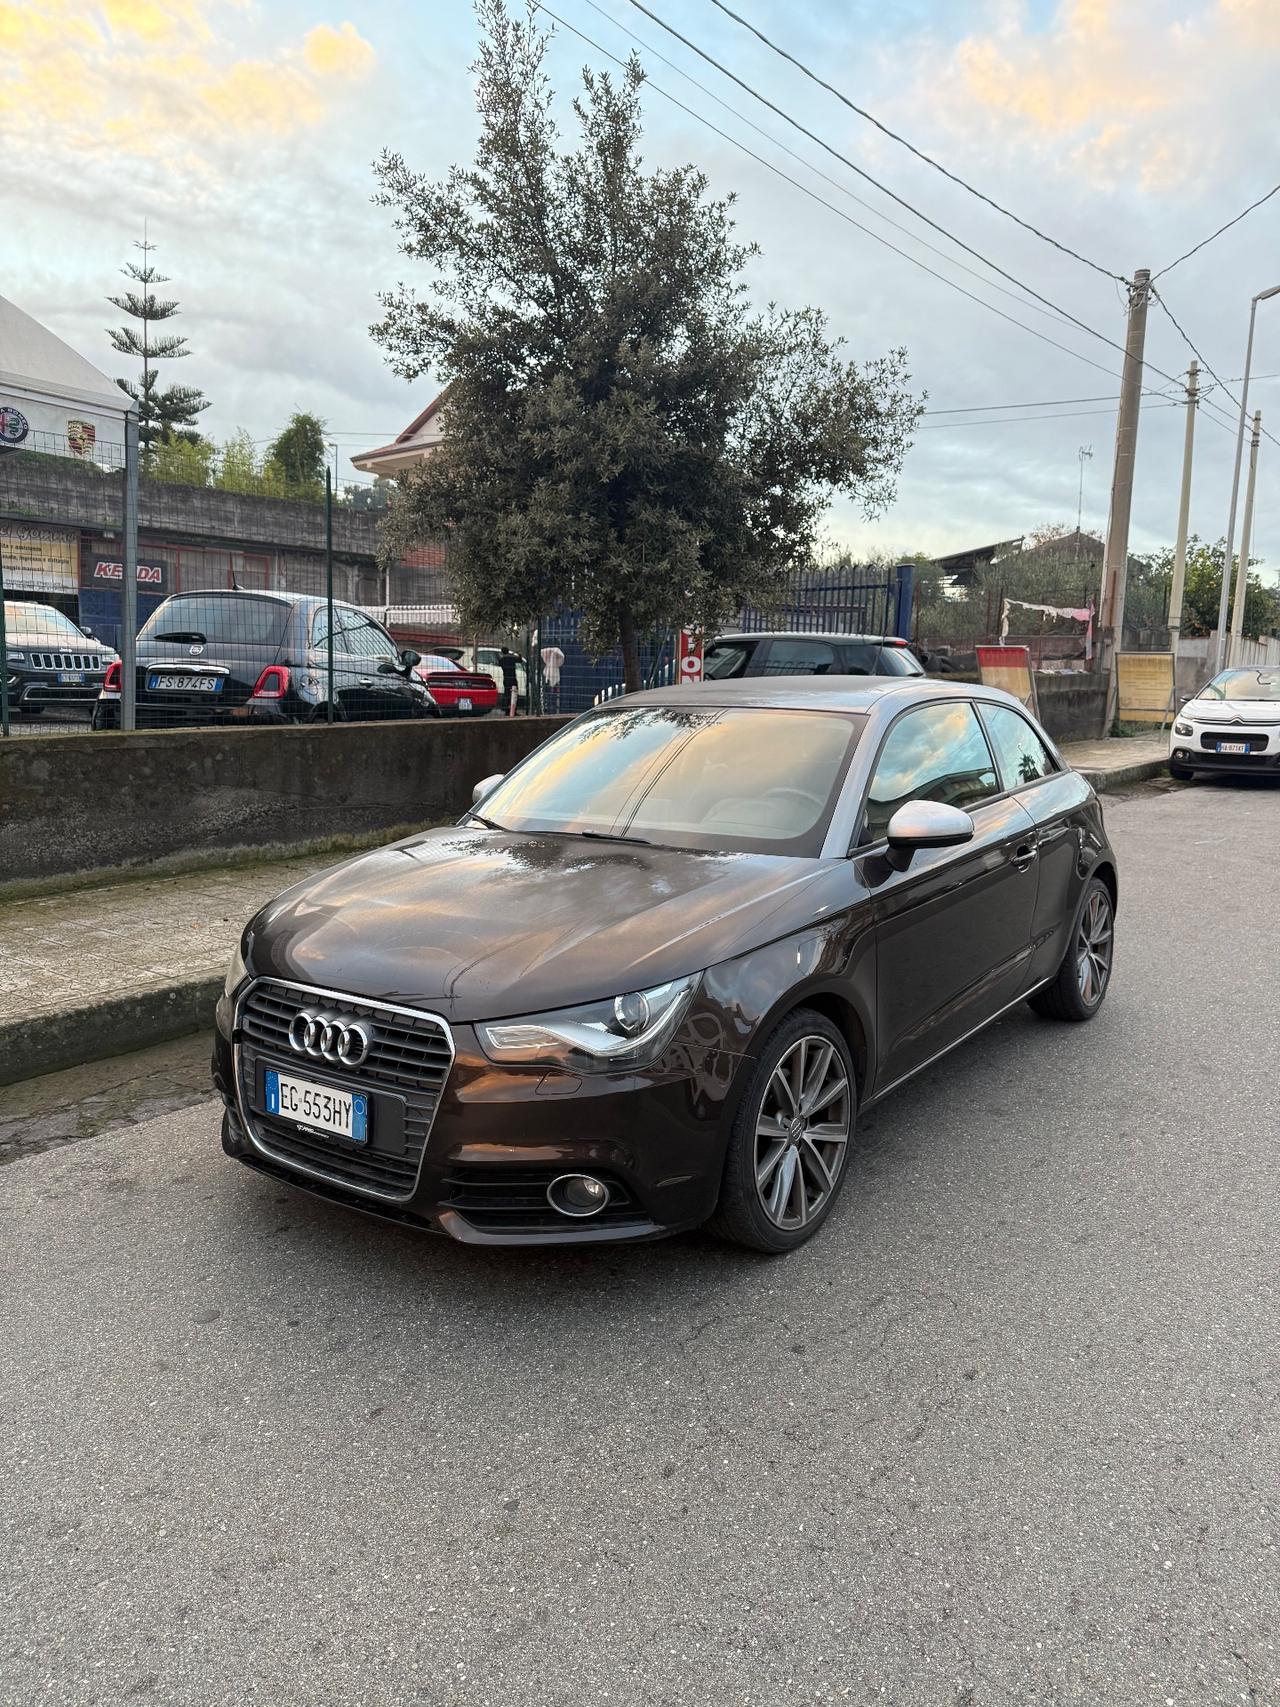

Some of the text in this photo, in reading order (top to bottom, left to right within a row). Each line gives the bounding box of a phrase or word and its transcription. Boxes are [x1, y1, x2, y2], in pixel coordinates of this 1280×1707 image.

[94, 561, 162, 583] KEDA
[158, 676, 174, 688] FS
[176, 677, 215, 690] 874FS
[280, 1083, 298, 1112] EG
[303, 1090, 352, 1129] 553HY
